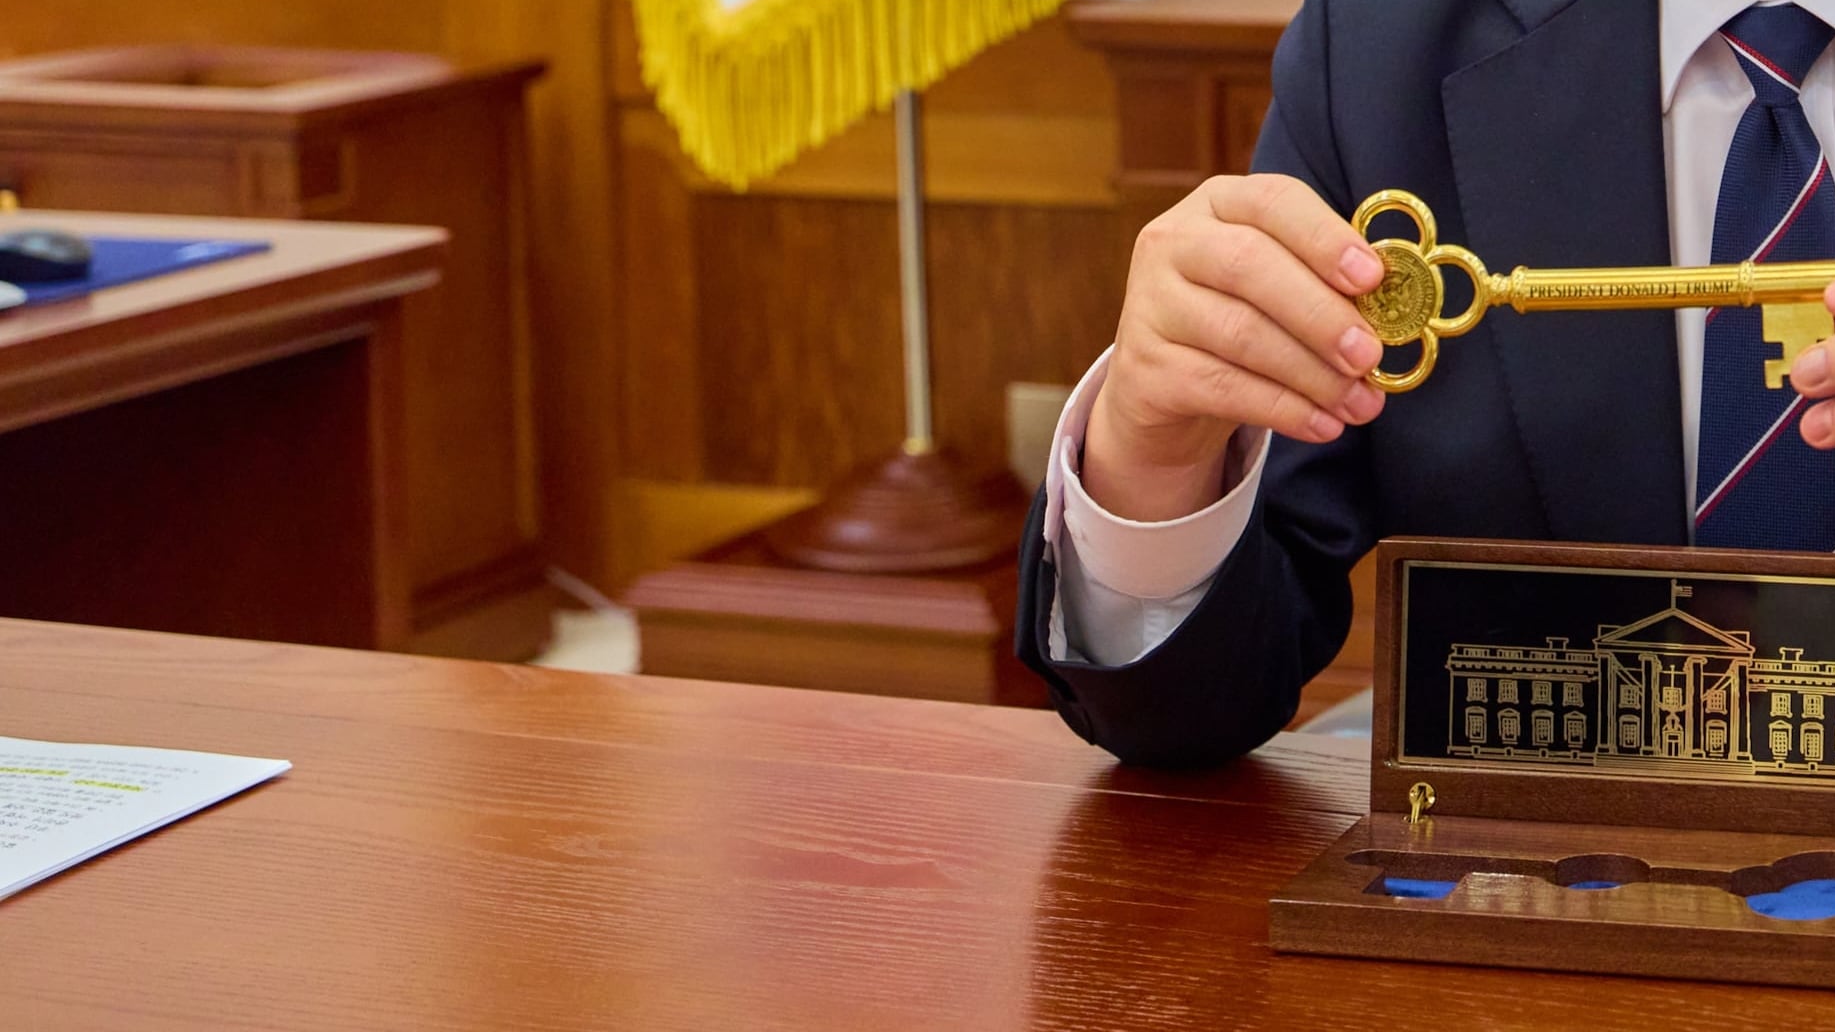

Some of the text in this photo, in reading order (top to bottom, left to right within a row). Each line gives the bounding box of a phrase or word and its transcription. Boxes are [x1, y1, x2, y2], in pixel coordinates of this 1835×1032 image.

[1529, 284, 1606, 297] PRESIDENT
[1608, 282, 1669, 296] DONALD
[1684, 280, 1733, 294] TRUMP
